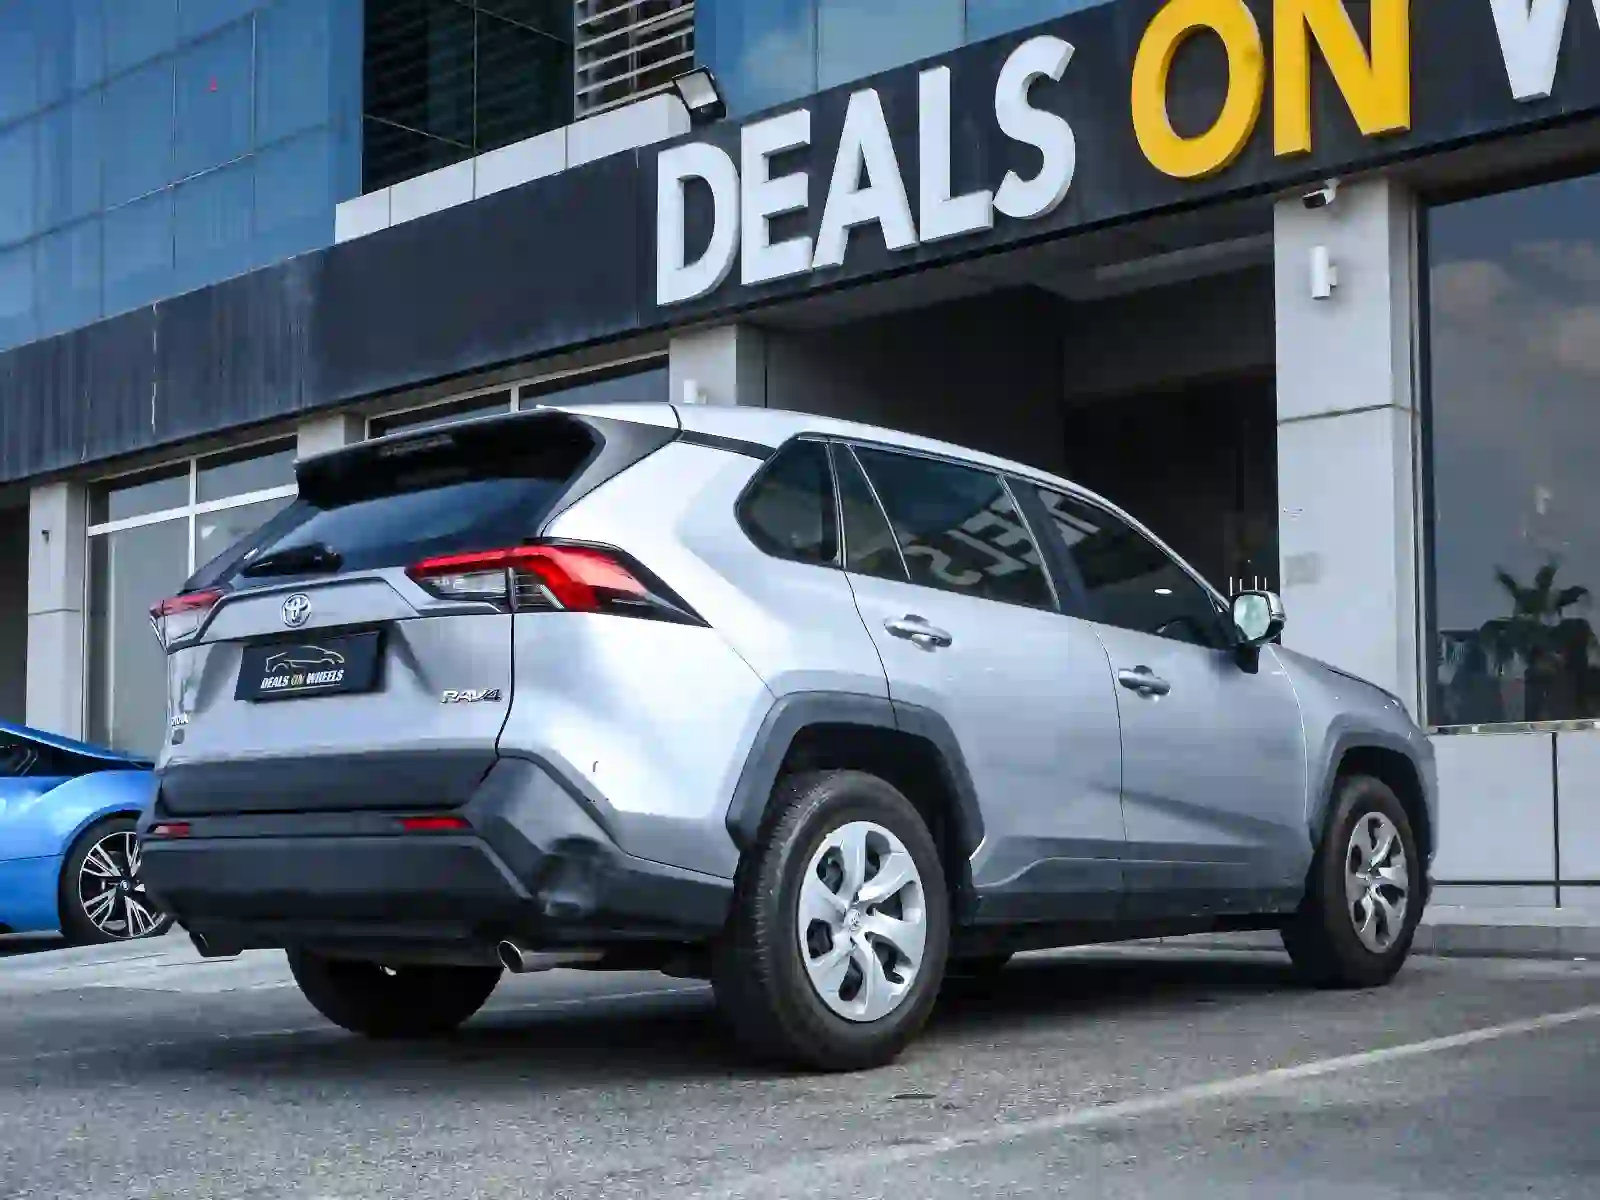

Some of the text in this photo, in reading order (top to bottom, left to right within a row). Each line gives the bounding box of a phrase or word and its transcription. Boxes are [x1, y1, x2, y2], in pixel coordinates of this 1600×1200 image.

[656, 34, 1076, 307] DEALS
[1130, 0, 1411, 179] ON
[260, 669, 345, 689] DEALS ON WHEELS
[440, 688, 502, 704] RAV4
